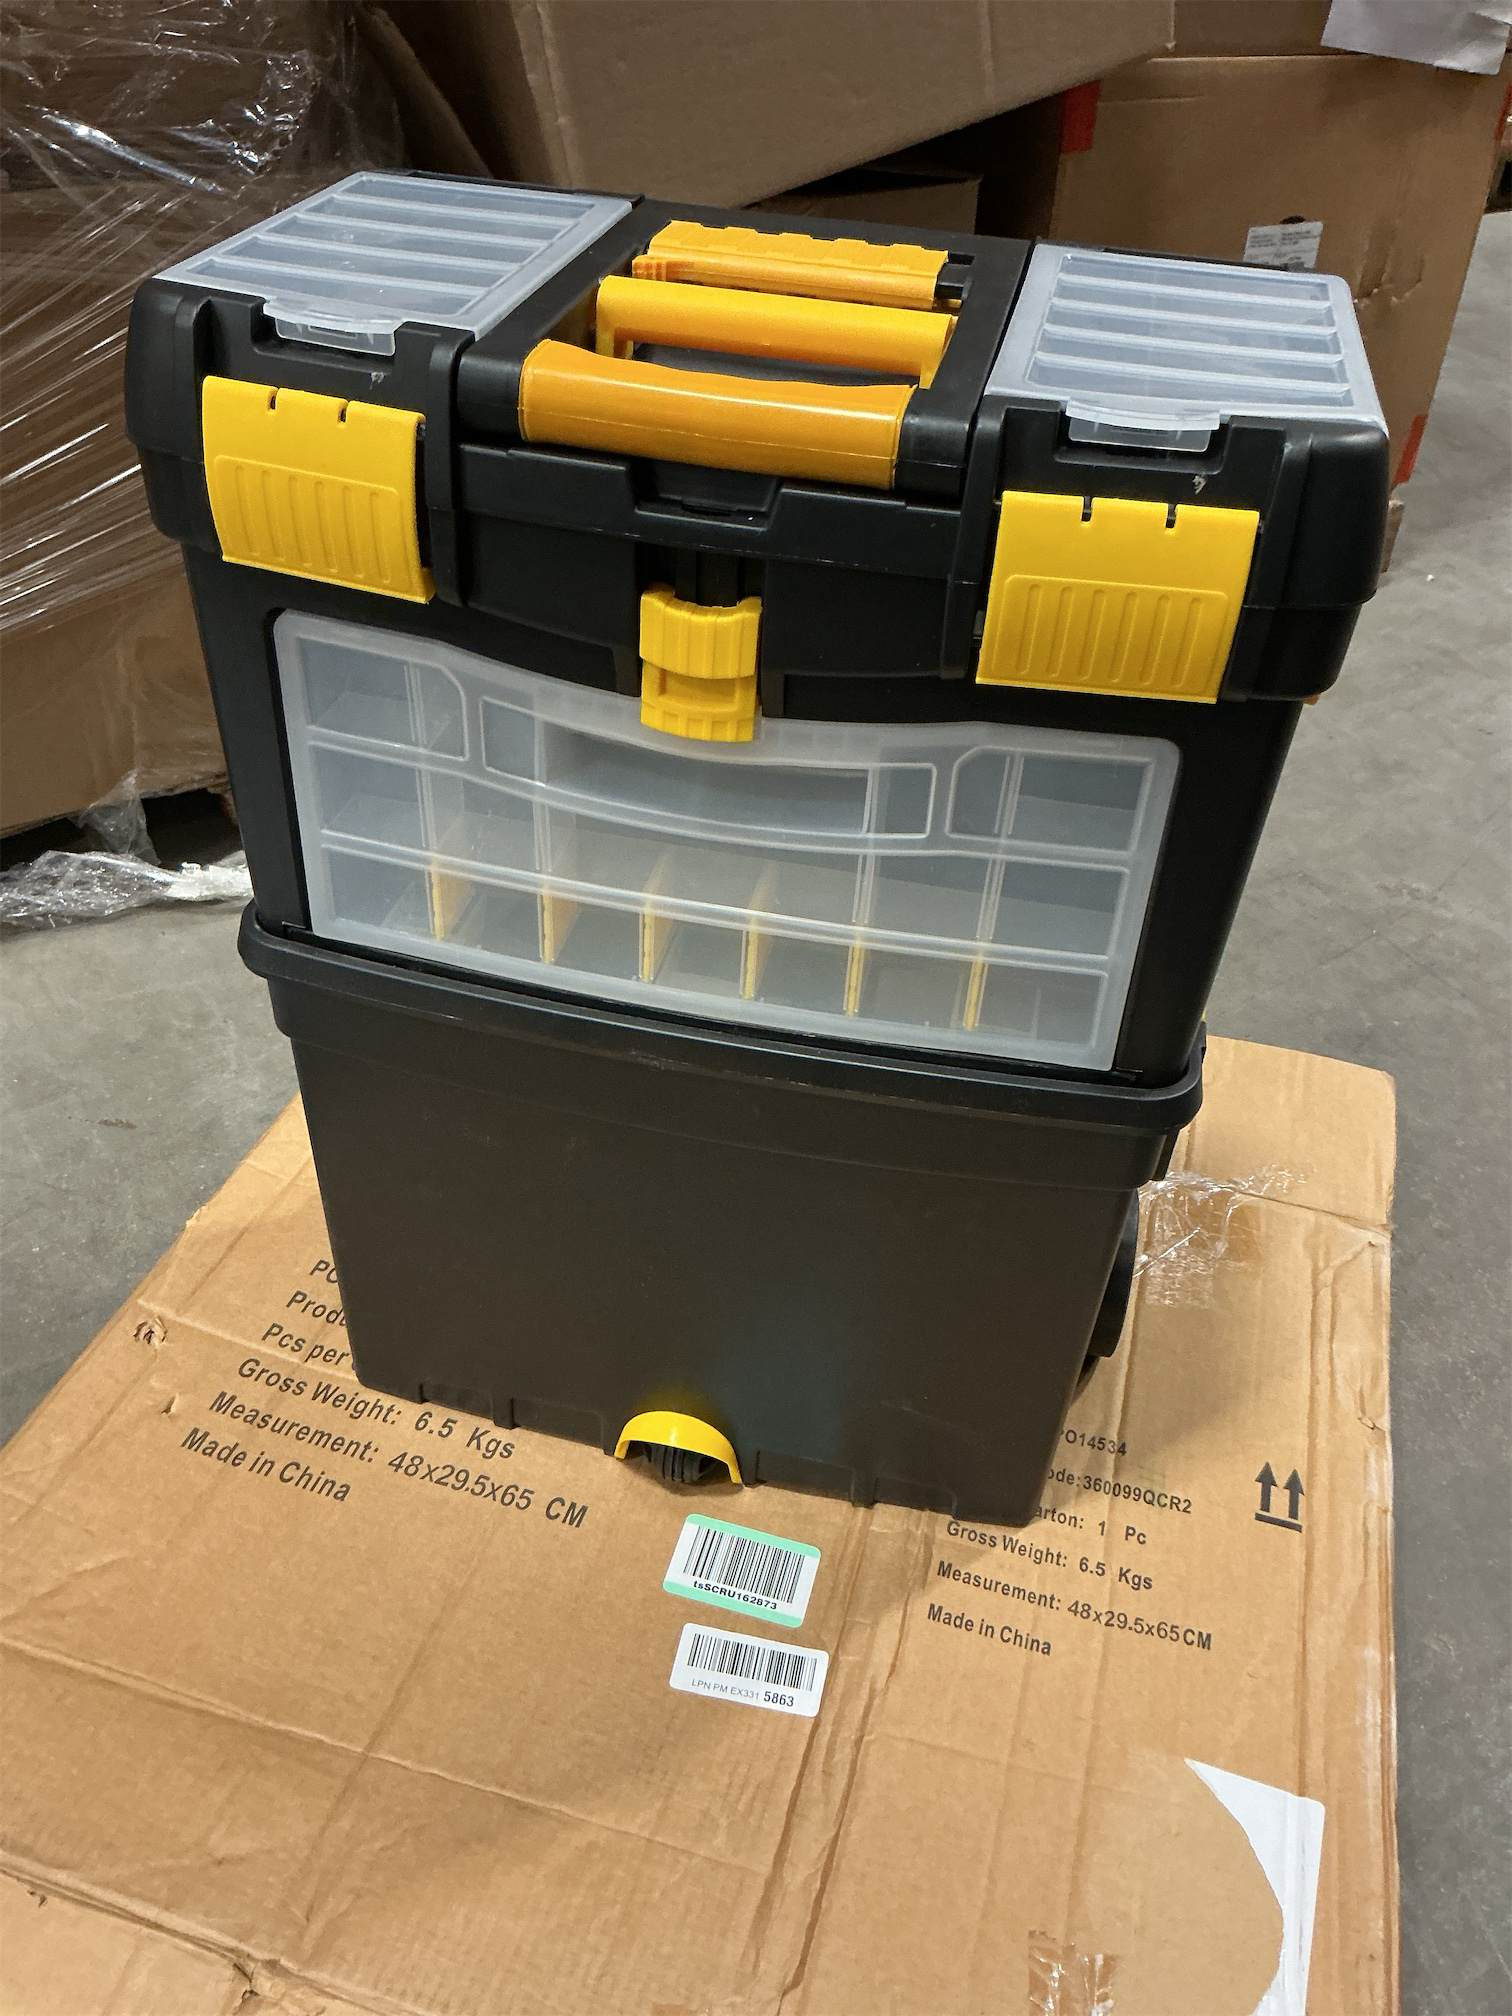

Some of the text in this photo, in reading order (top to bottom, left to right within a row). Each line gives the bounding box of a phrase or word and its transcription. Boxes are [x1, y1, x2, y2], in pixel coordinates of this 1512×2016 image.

[261, 1323, 350, 1366] Pcs per
[238, 1357, 515, 1460] Gross Weight: 6.5 Kgs
[181, 1427, 351, 1502] Made in China
[209, 1390, 589, 1529] Measurement: 48x29.5x65 CM
[1061, 1429, 1128, 1457] O14534
[947, 1520, 1153, 1591] Gross Weight: 6.5 Kgs
[1098, 1520, 1106, 1537] 1
[1125, 1525, 1147, 1545] Pc
[693, 1580, 778, 1610] tsSCRU162873
[937, 1560, 1061, 1611] Measurement:
[927, 1603, 1052, 1656] Made in China
[692, 1679, 795, 1708] LPN PM EX331 5863
